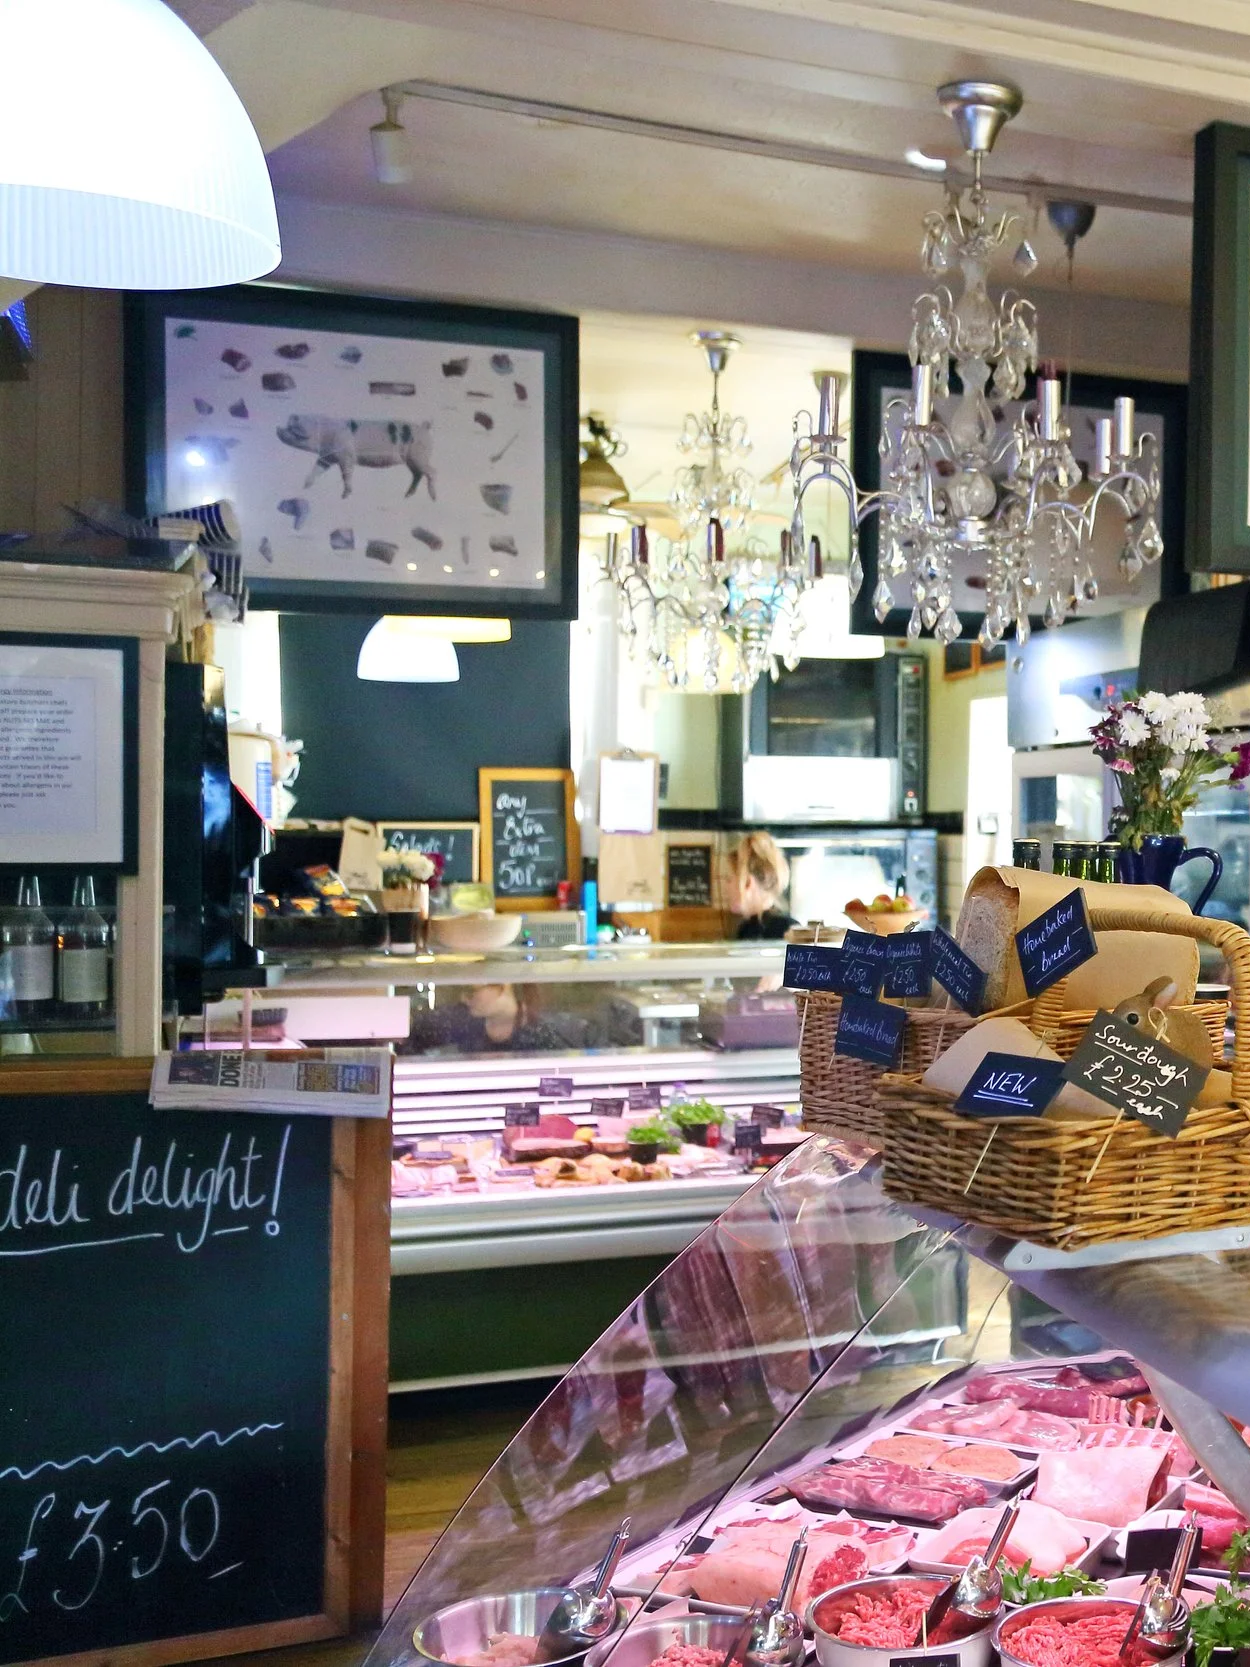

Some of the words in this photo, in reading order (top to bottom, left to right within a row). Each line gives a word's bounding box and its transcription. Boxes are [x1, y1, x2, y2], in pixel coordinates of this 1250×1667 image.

[1022, 905, 1073, 955] Homebaked
[1041, 936, 1072, 972] bread
[1083, 1055, 1157, 1098] £2.25
[1095, 1024, 1190, 1088] Sourdough
[983, 1072, 1037, 1095] NEW
[1127, 1098, 1165, 1121] each
[0, 1145, 90, 1230] deli
[108, 1124, 292, 1252] delight!
